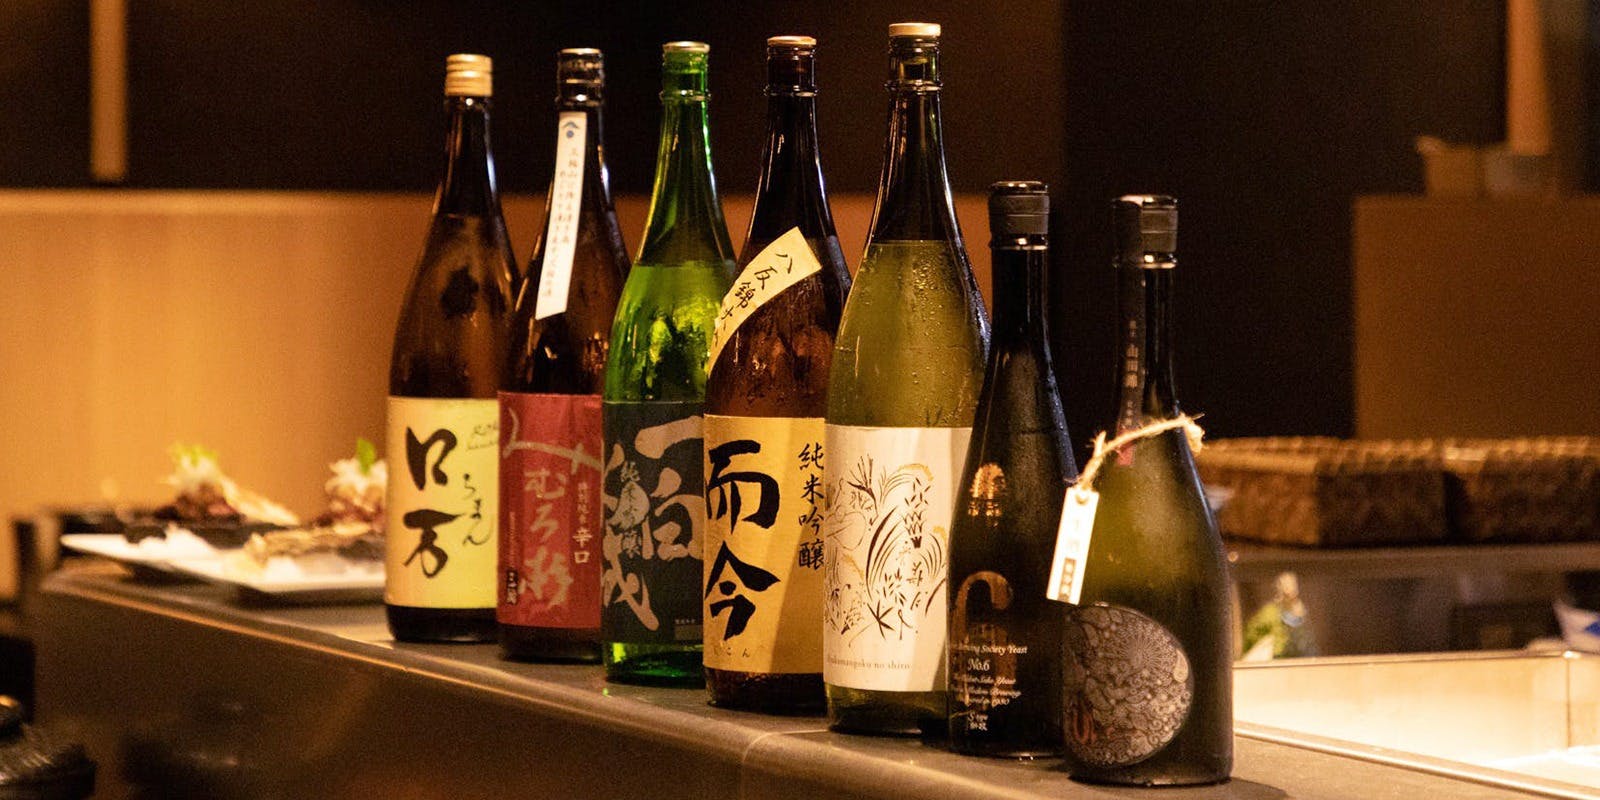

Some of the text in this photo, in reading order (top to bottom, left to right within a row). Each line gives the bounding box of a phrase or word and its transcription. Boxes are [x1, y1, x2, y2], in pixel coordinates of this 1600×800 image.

[797, 442, 825, 571] 純米吟醸
[572, 526, 593, 564] 辛口
[704, 439, 781, 641] 而今
[967, 658, 991, 672] No.6
[981, 644, 1006, 657] Society
[1006, 643, 1029, 655] Yeast
